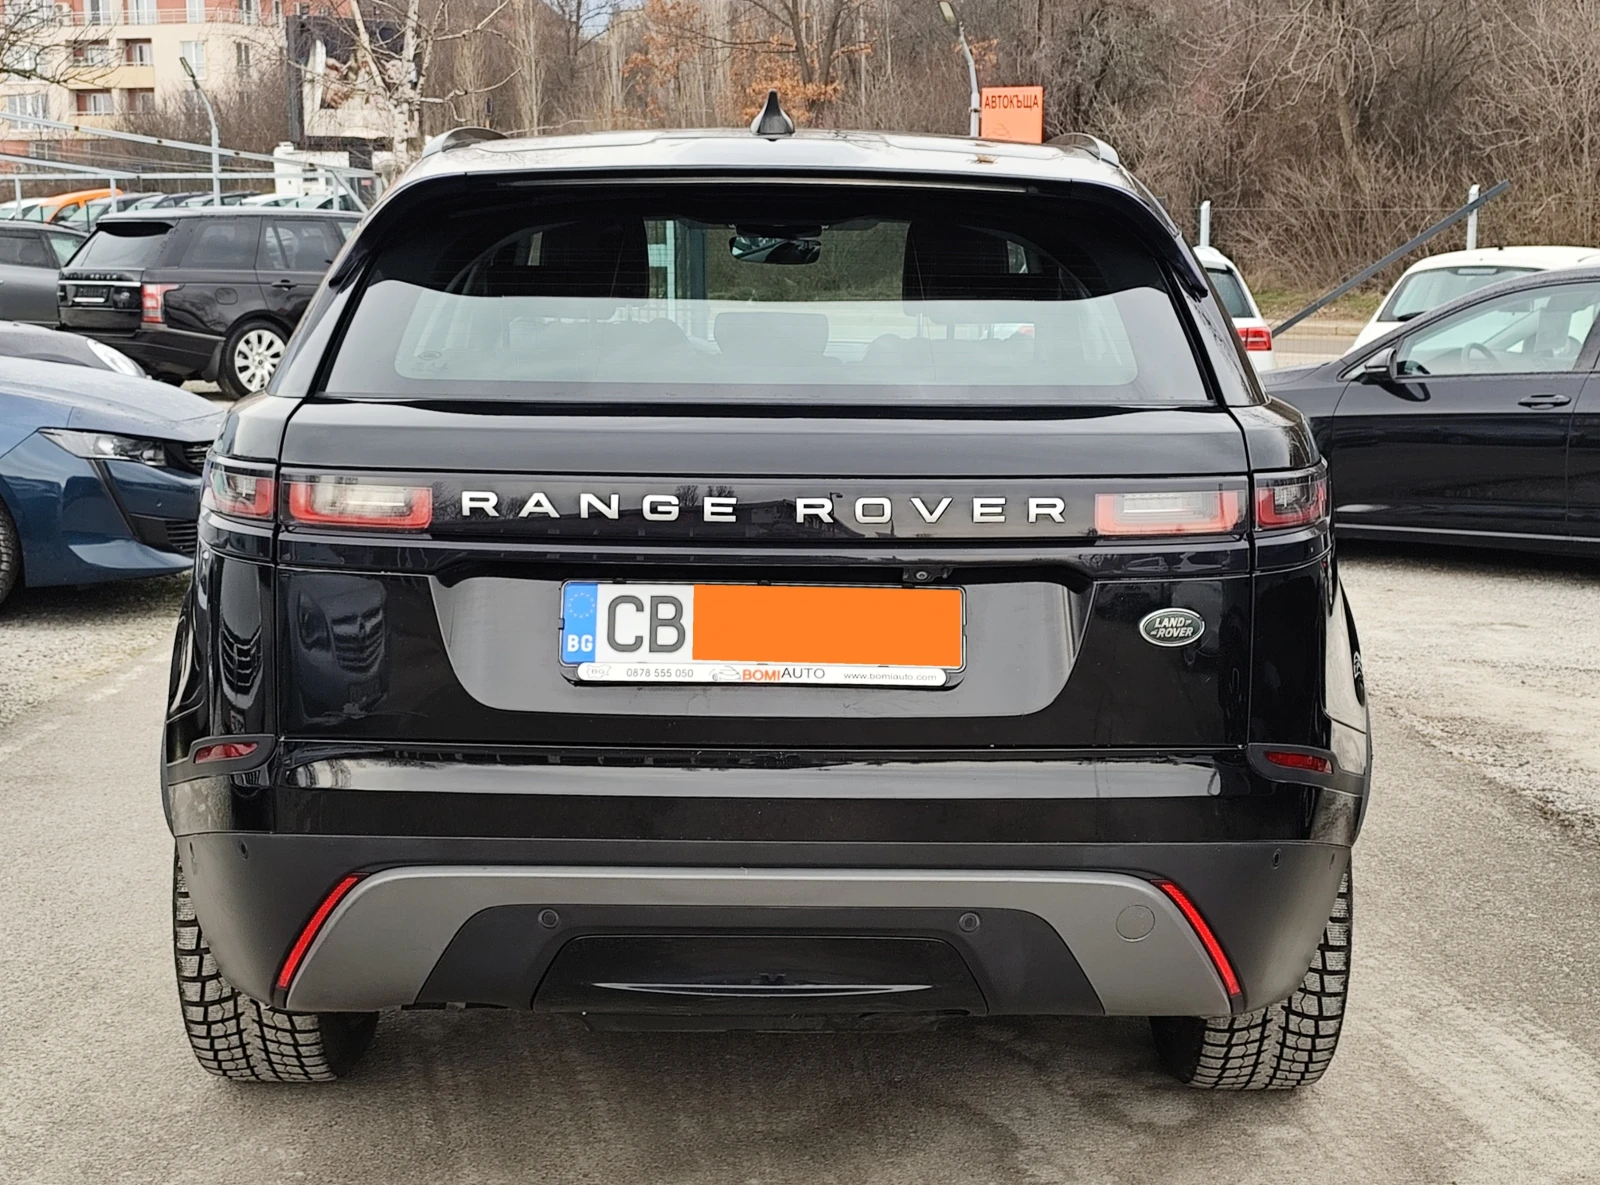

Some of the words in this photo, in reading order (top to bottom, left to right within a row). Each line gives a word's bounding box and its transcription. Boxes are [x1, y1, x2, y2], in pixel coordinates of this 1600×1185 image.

[984, 94, 1039, 111] АВТОКЪЩА
[461, 491, 737, 522] RANGE
[796, 497, 1065, 523] ROVER
[607, 595, 686, 653] CB
[1154, 617, 1185, 628] LAND
[1156, 627, 1194, 638] ROVER
[567, 634, 593, 652] BG
[626, 668, 651, 677] 0878
[654, 668, 672, 677] 555
[675, 668, 694, 678] 050
[843, 672, 937, 681] www.bomiauto.com
